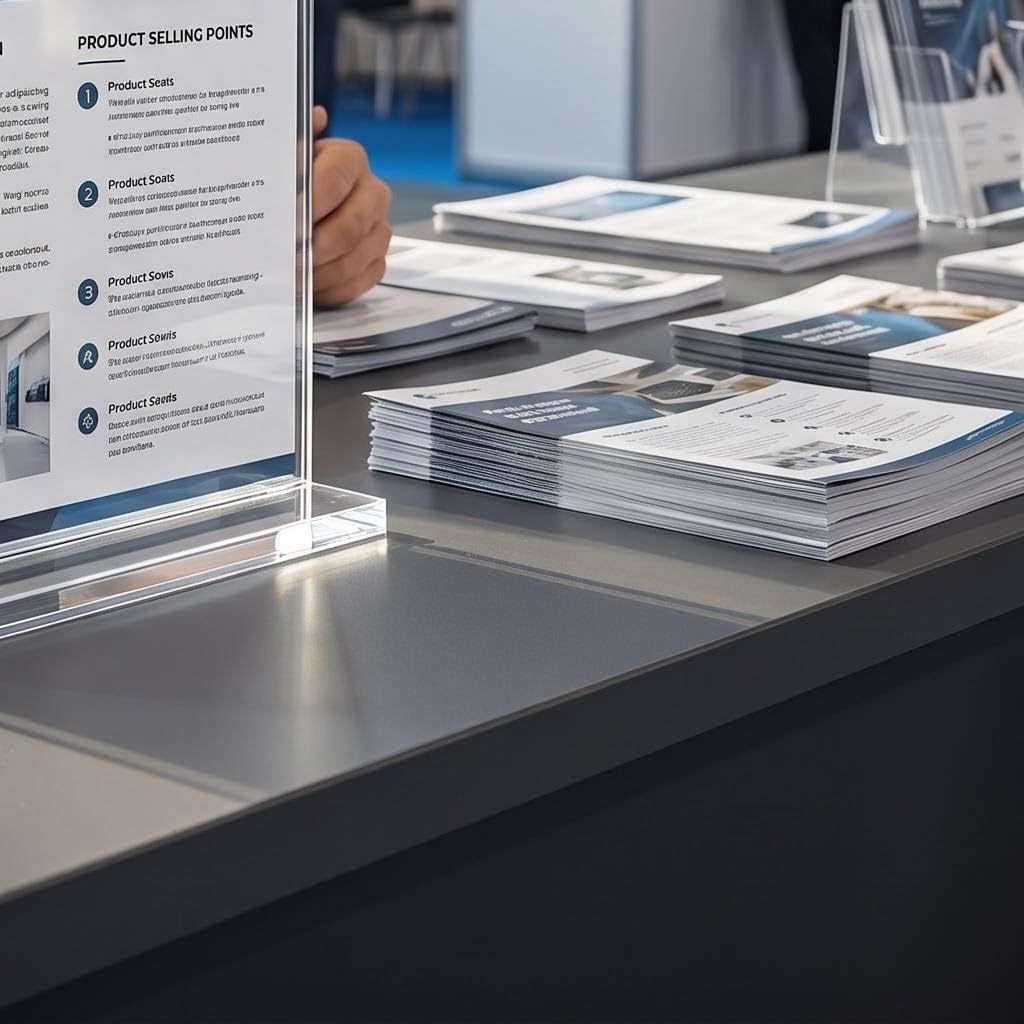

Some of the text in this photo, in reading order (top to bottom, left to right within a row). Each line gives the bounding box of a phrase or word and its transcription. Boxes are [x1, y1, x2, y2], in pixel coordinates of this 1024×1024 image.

[78, 24, 254, 50] PRODUCT SELLING POINTS
[108, 79, 147, 91] Product
[148, 77, 175, 89] Seats
[108, 176, 147, 190] Product
[108, 273, 148, 287] Product
[108, 336, 147, 351] Product
[108, 398, 147, 414] Product
